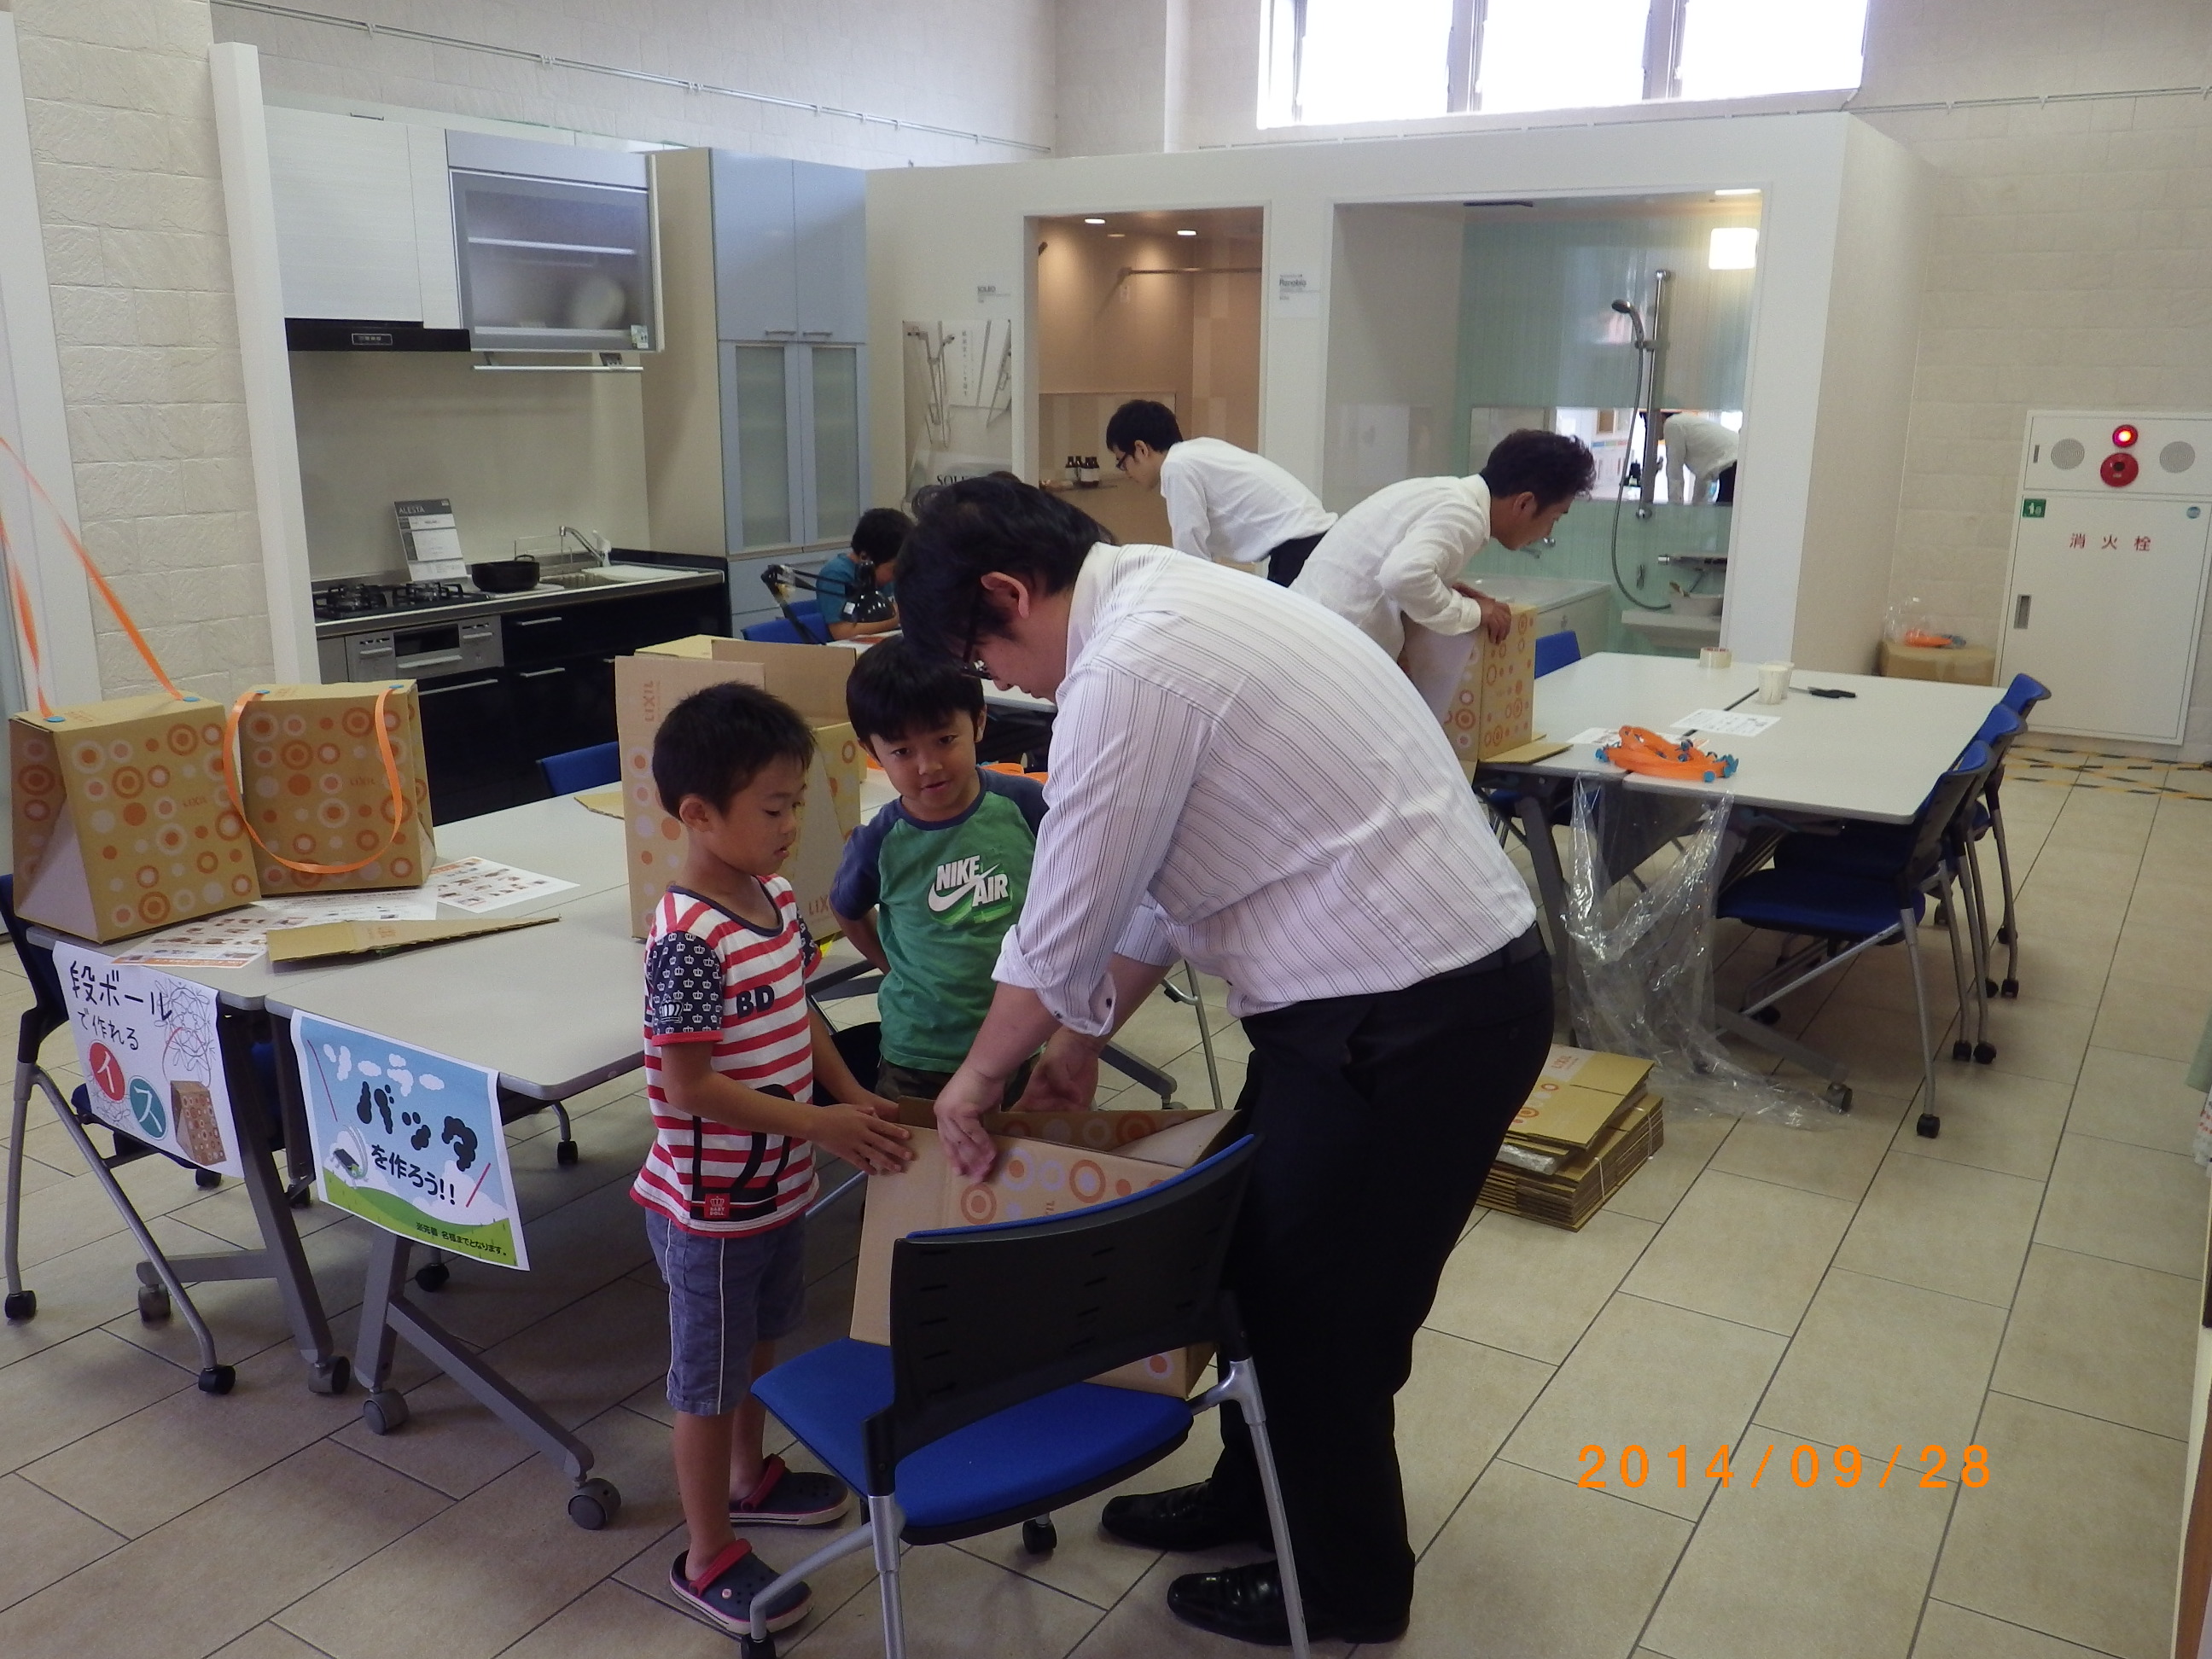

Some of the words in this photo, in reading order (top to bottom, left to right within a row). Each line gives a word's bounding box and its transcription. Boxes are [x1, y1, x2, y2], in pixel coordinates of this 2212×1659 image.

[2069, 533, 2151, 552] 消火栓
[643, 680, 655, 722] LIXIL
[935, 855, 981, 891] NIKE
[971, 873, 1009, 907] AIR
[808, 894, 830, 916] LIX
[70, 960, 172, 1022] 段ボール
[736, 984, 775, 1020] BD
[77, 1007, 138, 1051] で作れる
[323, 1043, 445, 1097] ソーラー
[356, 1080, 478, 1173] バッタ
[370, 1144, 456, 1205] を作ろう!!
